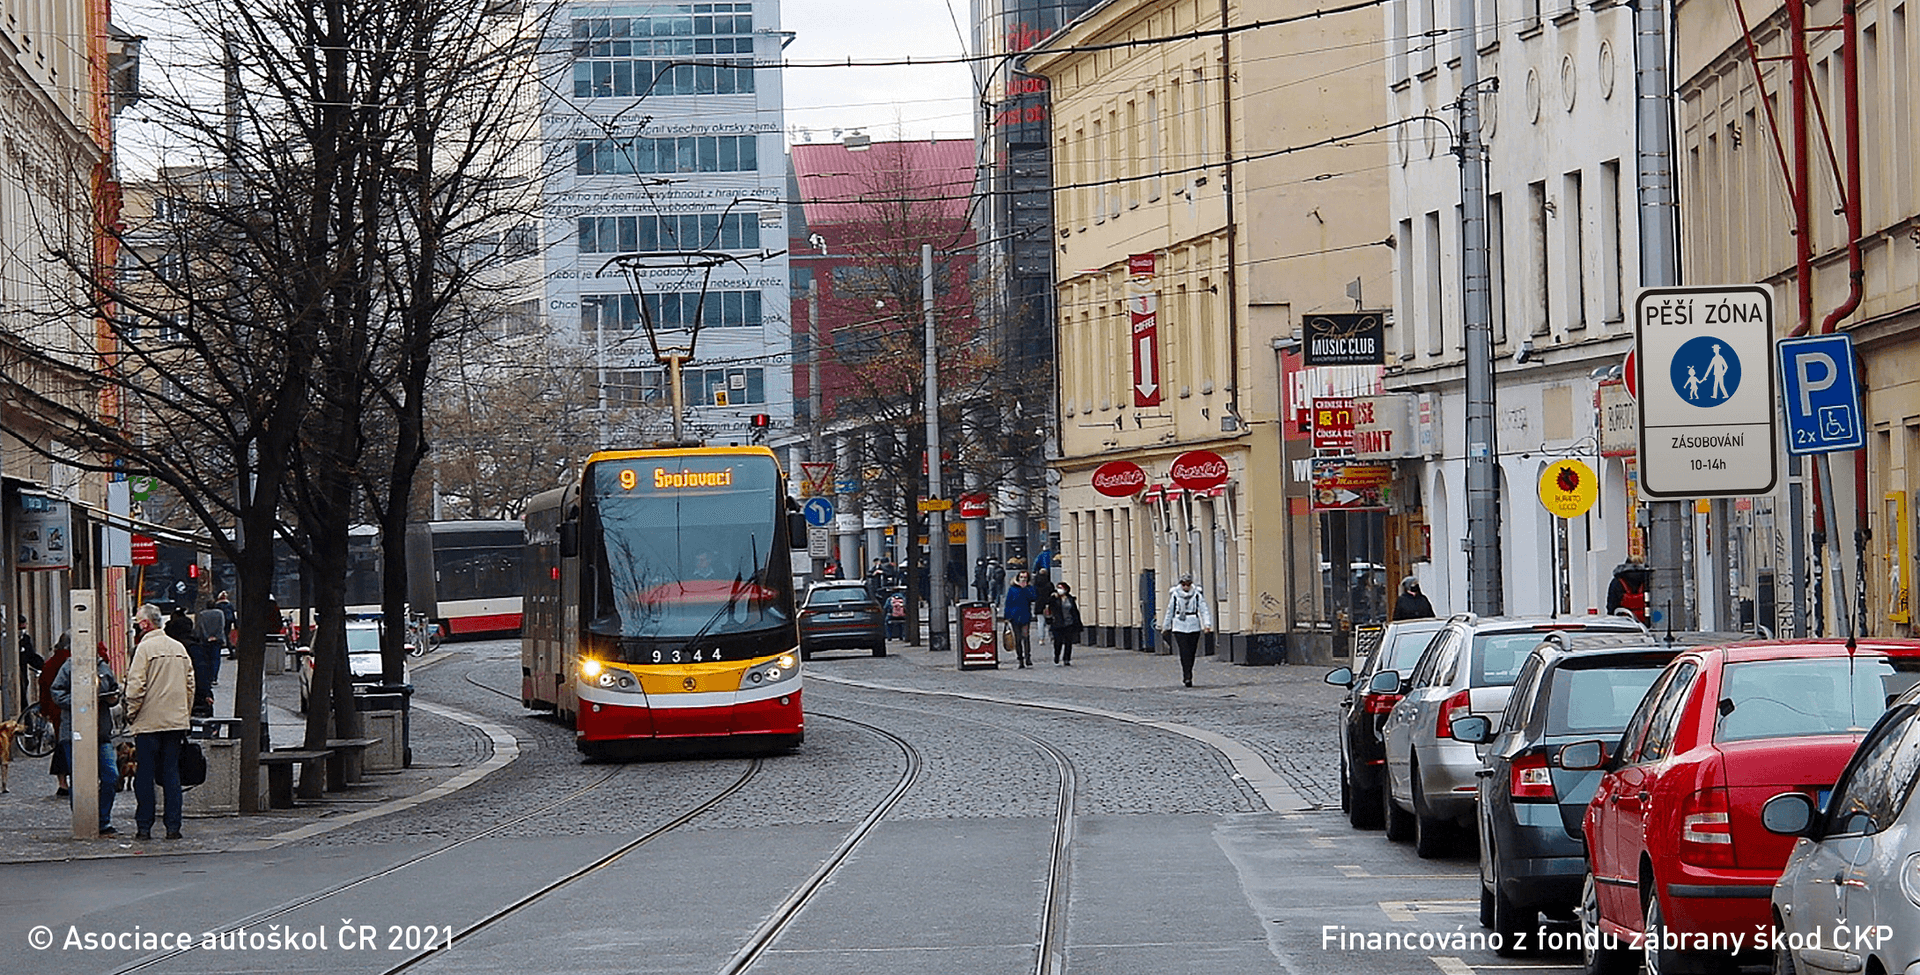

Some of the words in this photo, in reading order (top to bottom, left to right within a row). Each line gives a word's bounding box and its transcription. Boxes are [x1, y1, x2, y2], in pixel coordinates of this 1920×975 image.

[1645, 299, 1693, 326] PĚŠÍ
[1705, 298, 1764, 324] ZÓNA
[1134, 316, 1156, 334] COFFEE
[1311, 339, 1346, 356] MUSIC
[1348, 338, 1375, 354] CLUB
[1795, 352, 1838, 417] P
[1671, 433, 1744, 449] ZÁSOBOVÁNÍ
[1797, 429, 1817, 444] 2x
[1690, 458, 1727, 471] 10-14h
[620, 469, 637, 491] 9
[653, 467, 733, 489] Spojovací
